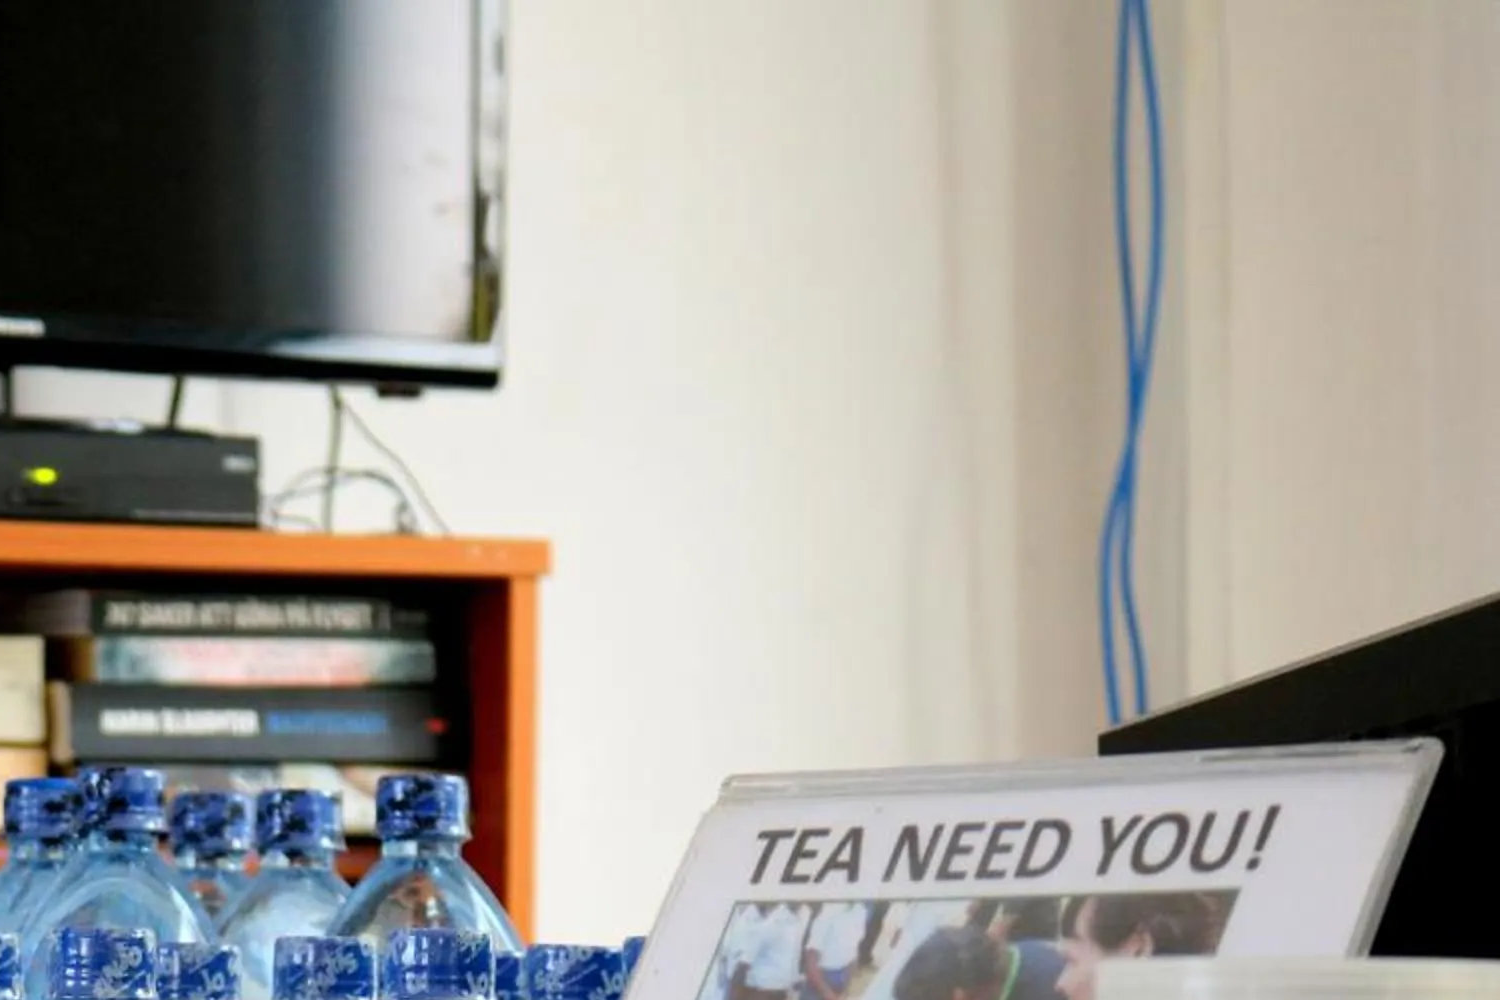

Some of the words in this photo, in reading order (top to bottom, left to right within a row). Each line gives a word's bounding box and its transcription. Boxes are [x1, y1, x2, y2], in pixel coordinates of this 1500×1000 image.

[748, 826, 864, 885] TEA
[880, 817, 1074, 883] NEED
[1095, 803, 1283, 877] YOU!
